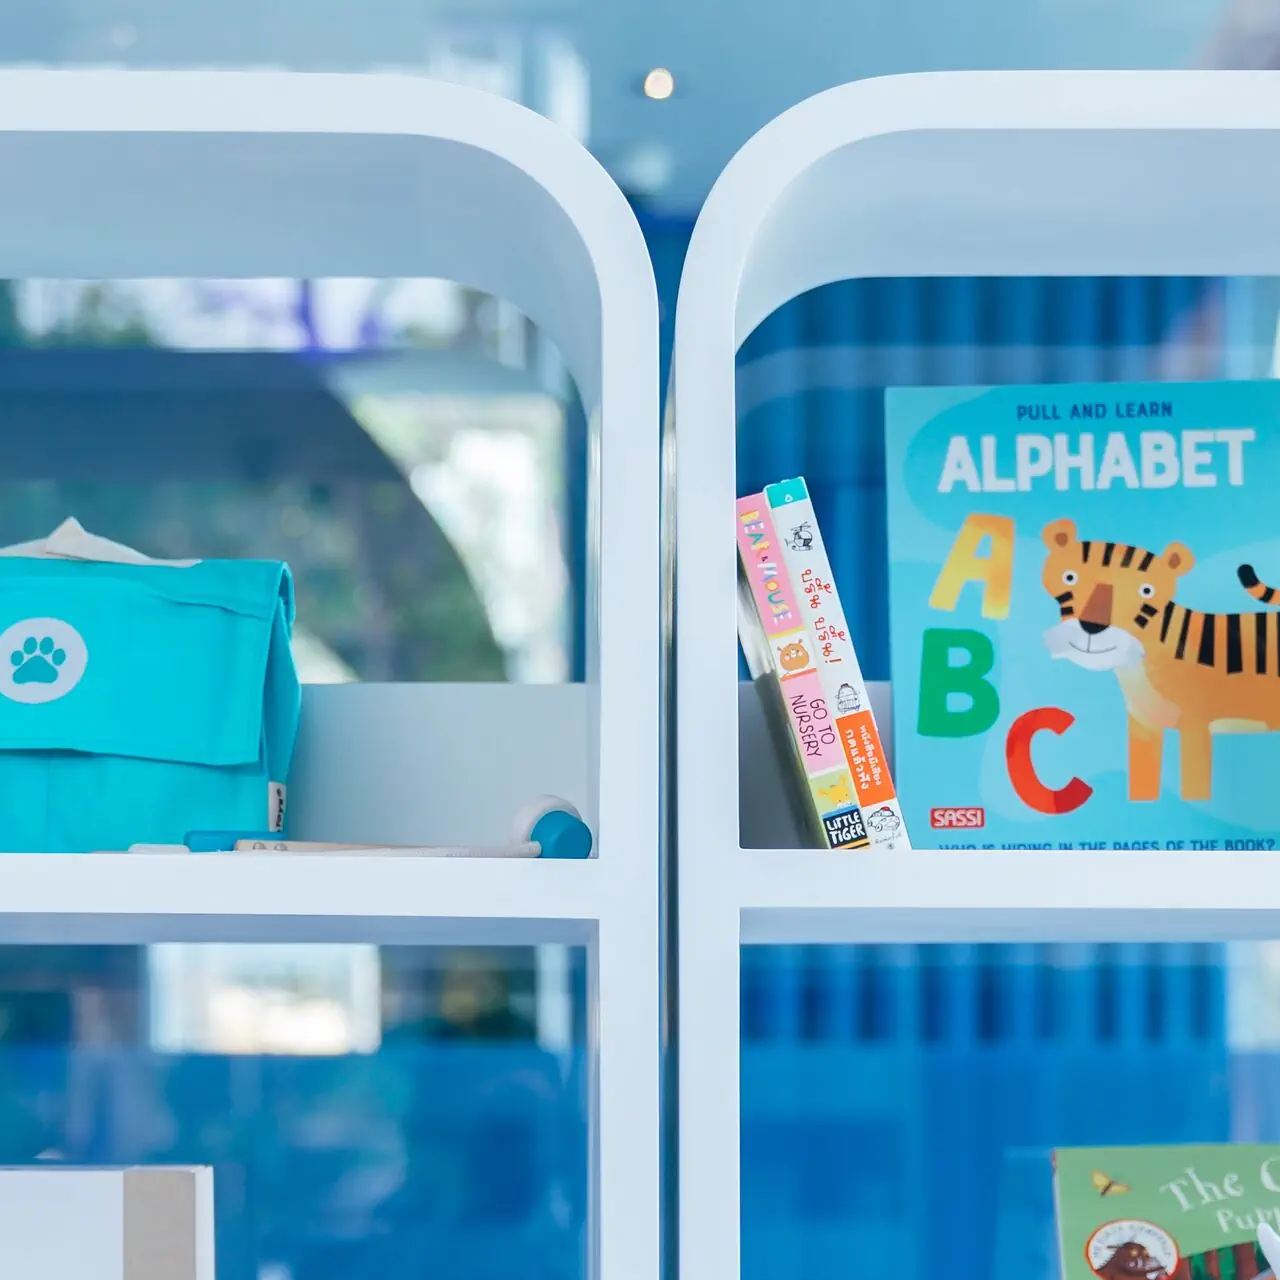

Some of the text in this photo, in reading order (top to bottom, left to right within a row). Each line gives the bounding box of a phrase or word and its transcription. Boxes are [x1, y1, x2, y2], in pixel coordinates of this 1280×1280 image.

[1017, 401, 1174, 421] PULL AND LEARN
[937, 428, 1256, 493] ALPHABET
[927, 512, 1016, 620] A
[916, 627, 1001, 739] B
[788, 694, 822, 758] NURSERY
[809, 698, 836, 745] GO TO
[1005, 706, 1094, 815] C
[933, 809, 982, 828] SASSI
[1159, 1166, 1245, 1213] The
